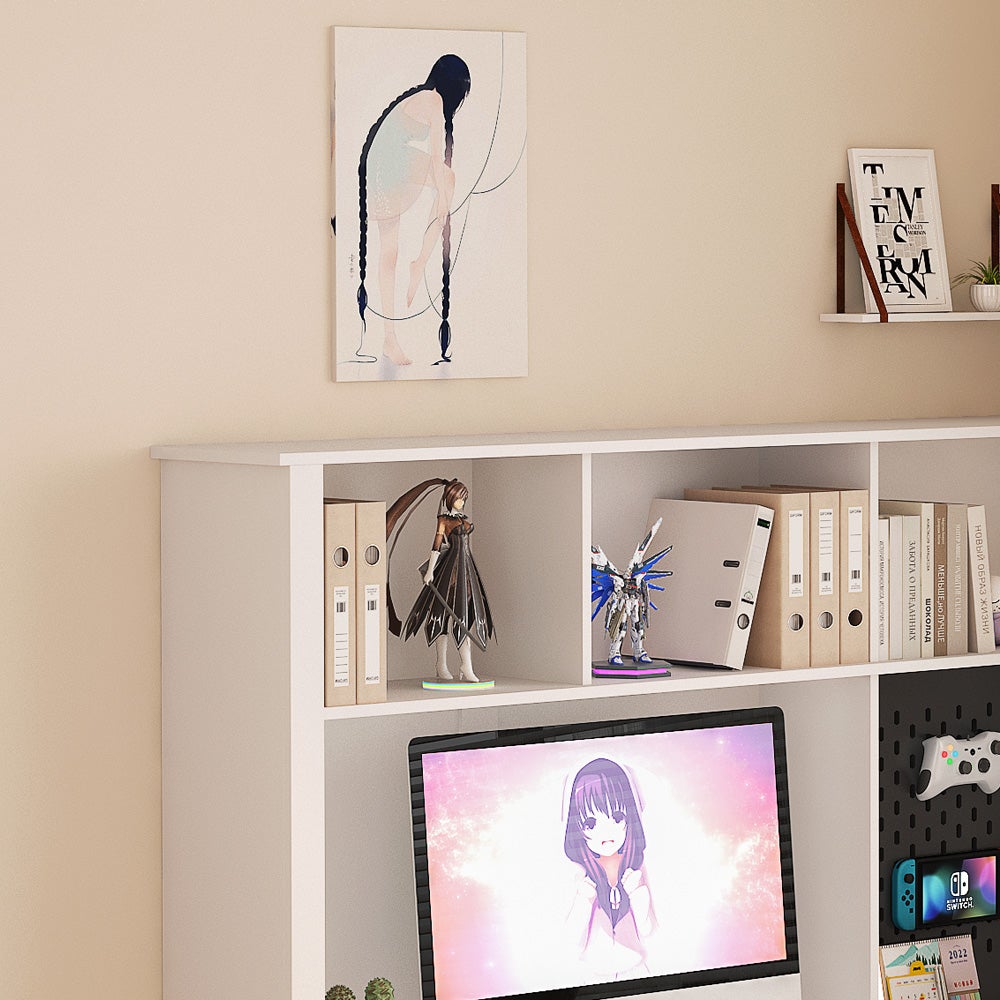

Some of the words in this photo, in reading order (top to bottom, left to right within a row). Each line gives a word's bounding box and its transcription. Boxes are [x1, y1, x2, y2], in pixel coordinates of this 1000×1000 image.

[908, 540, 917, 574] ЗАБОТА
[973, 524, 986, 561] НОВЫЙ
[977, 563, 987, 595] ОБРАЗ
[924, 598, 932, 643] ШОКОЛАД
[979, 598, 990, 636] ЖИЗНИ
[949, 948, 968, 960] 2022
